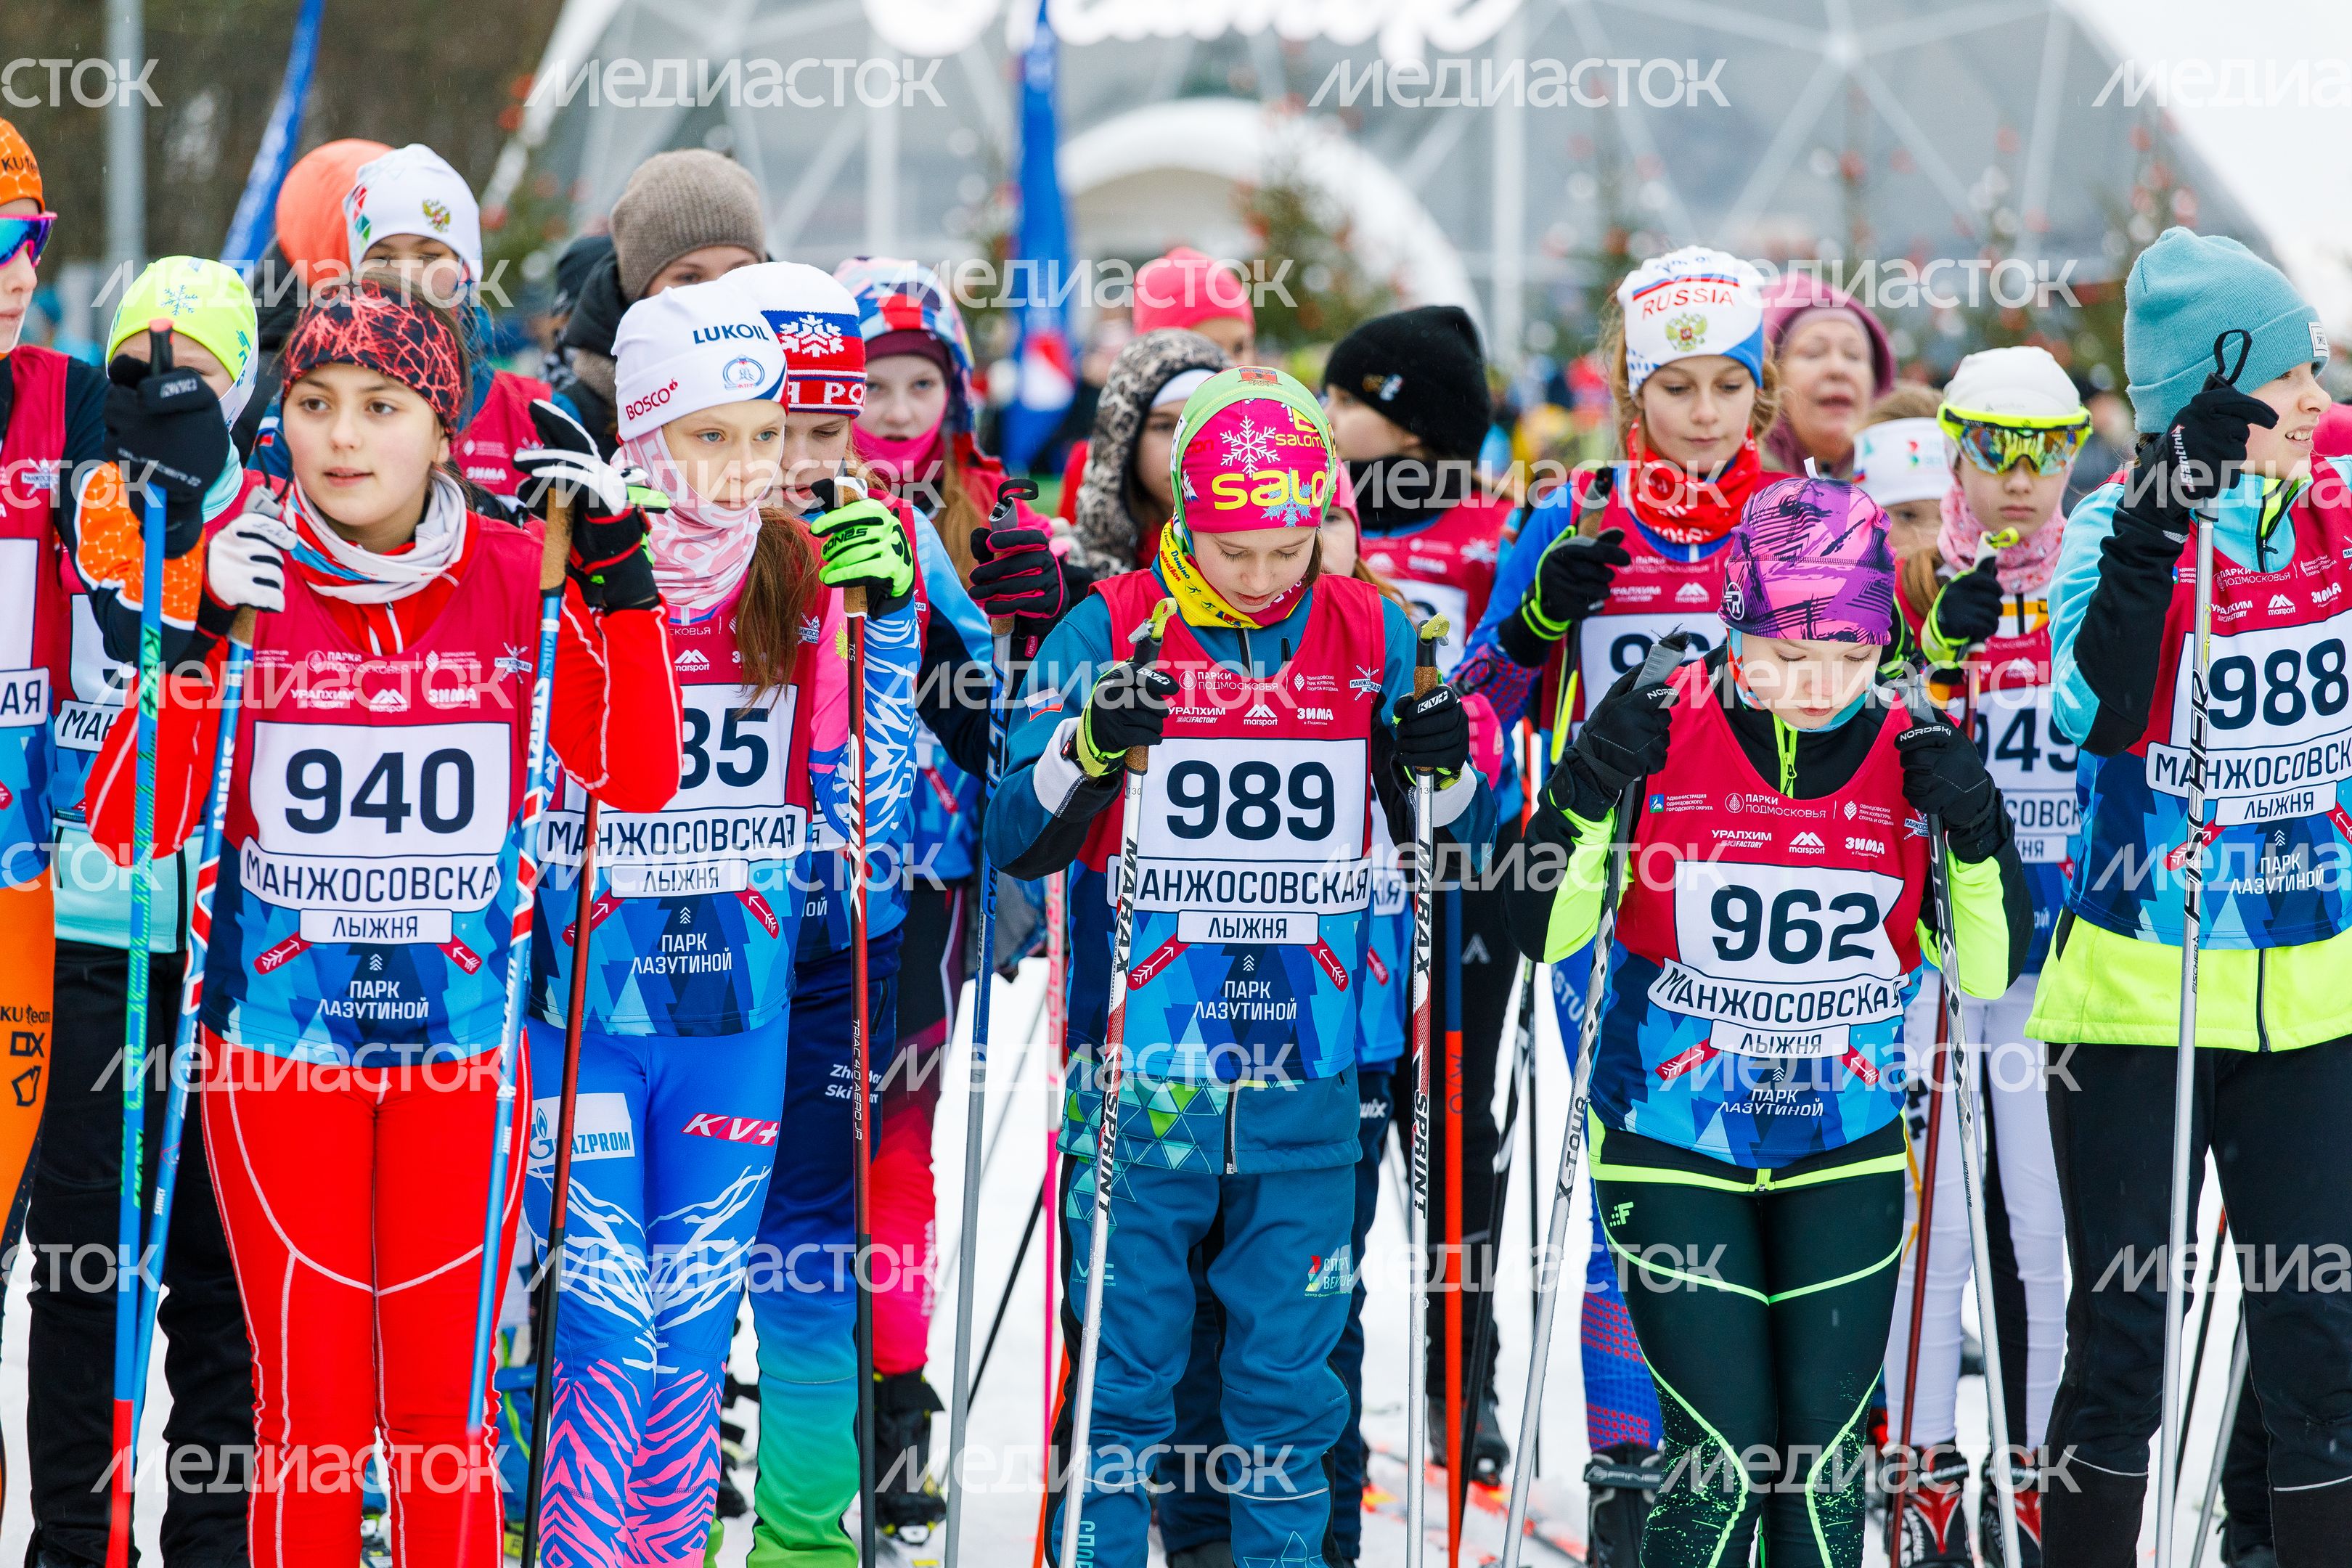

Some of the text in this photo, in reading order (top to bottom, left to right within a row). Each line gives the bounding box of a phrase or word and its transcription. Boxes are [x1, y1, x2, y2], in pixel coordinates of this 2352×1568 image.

[1642, 288, 1734, 321] RUSSIA
[693, 324, 769, 344] LUKOIL
[626, 388, 671, 422] BOSCO
[1159, 550, 1182, 582] marathon
[1170, 549, 1191, 580] Domino
[2219, 568, 2251, 579] ПАРКИ
[2268, 606, 2296, 616] marsport
[674, 663, 711, 672] marsport
[1198, 671, 1232, 681] ПАРКИ
[1199, 681, 1278, 691] ПОДМОСКОВЬЯ
[2208, 637, 2350, 730] 988
[1169, 706, 1226, 716] УРАЛХИМ
[1417, 690, 1449, 714] KV+
[1243, 718, 1278, 727] marsport
[1297, 708, 1334, 721] ЗИМА
[1899, 726, 1952, 743] NORDSKI
[285, 748, 475, 834] 940
[1167, 760, 1336, 841] 989
[1745, 793, 1779, 806] ПАРКИ
[2184, 669, 2209, 926] FISCHER
[1745, 804, 1826, 819] ПОДМОСКОВЬЯ
[2244, 791, 2315, 820] ЛЫЖНЯ
[1711, 829, 1772, 841] УРАЛХИМ
[1845, 836, 1885, 855] ЗИМА
[1789, 846, 1826, 855] marsport
[2260, 852, 2301, 874] ПАРК
[643, 866, 719, 893] ЛЫЖНЯ
[2229, 865, 2324, 895] ЛАЗУТИНОЙ
[1116, 836, 1138, 977] MARAX
[1416, 838, 1432, 977] MARAX
[332, 916, 419, 939] ЛЫЖНЯ
[1208, 917, 1288, 939] ЛЫЖНЯ
[1711, 884, 1880, 965] 962
[661, 934, 708, 953] ПАРК
[630, 947, 732, 974] ЛАЗУТИНОЙ
[349, 981, 400, 1000] ПАРК
[1225, 980, 1271, 1000] ПАРК
[319, 995, 429, 1020] ЛАЗУТИНОЙ
[1193, 997, 1298, 1021] ЛАЗУТИНОЙ
[1740, 1032, 1822, 1055] ЛЫЖНЯ
[854, 1081, 862, 1121] AERO
[1750, 1087, 1798, 1104] ПАРК
[1718, 1098, 1824, 1117] ЛАЗУТИНОЙ
[555, 1131, 632, 1155] AZPROM
[1098, 1090, 1119, 1220] SPRINT
[1413, 1090, 1428, 1220] SPRINT
